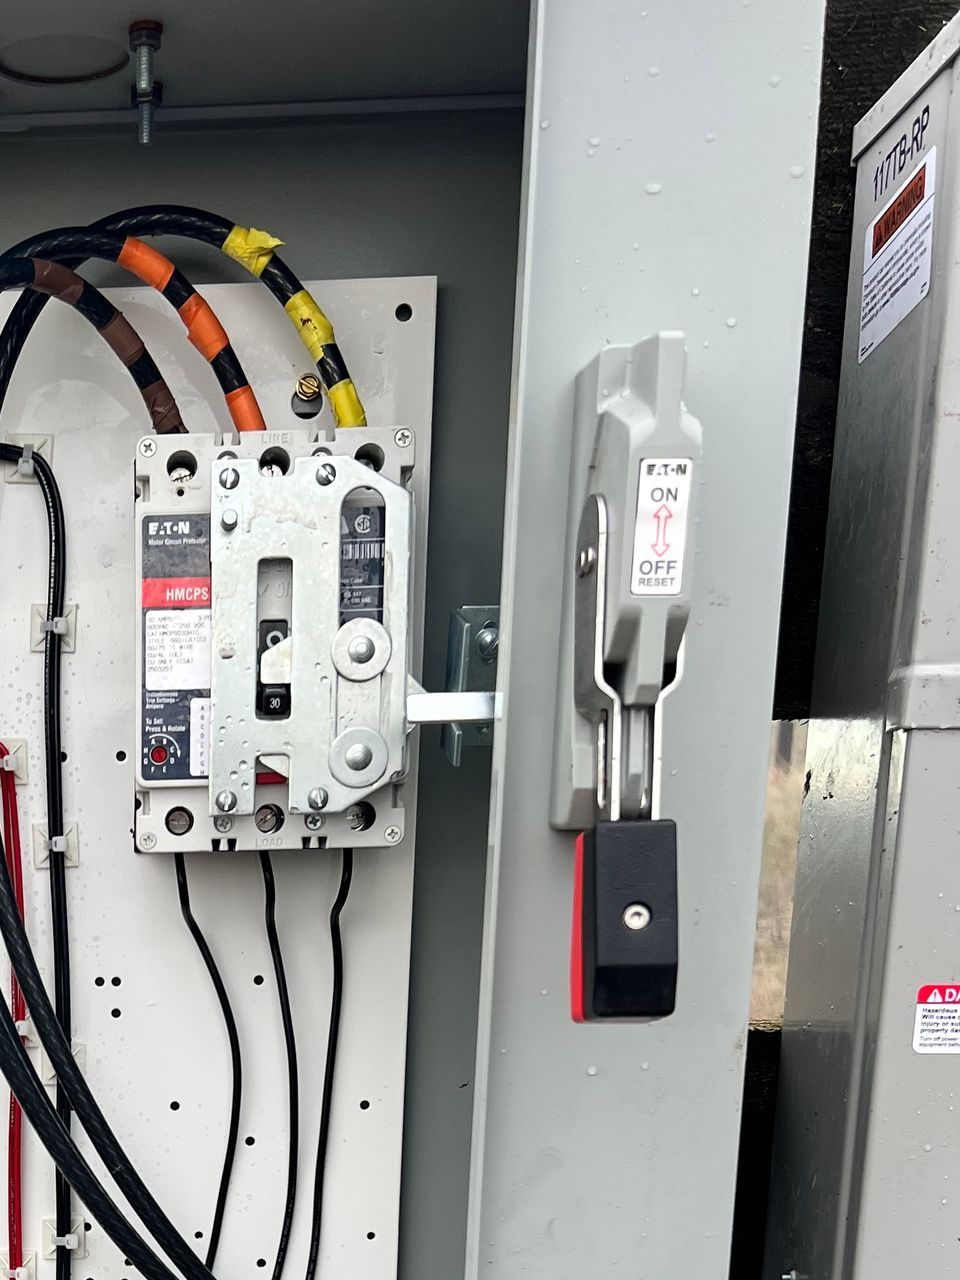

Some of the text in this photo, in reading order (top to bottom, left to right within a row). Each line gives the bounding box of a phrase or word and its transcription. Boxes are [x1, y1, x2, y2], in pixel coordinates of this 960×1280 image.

[884, 175, 924, 236] WARNING
[261, 433, 289, 444] LINE
[646, 464, 687, 476] EATON
[650, 487, 678, 502] ON
[148, 521, 190, 535] EATON
[639, 560, 677, 575] OFF
[638, 577, 676, 587] RESET
[166, 587, 209, 601] HMCPS
[269, 697, 281, 709] 30
[255, 838, 283, 848] LOAD
